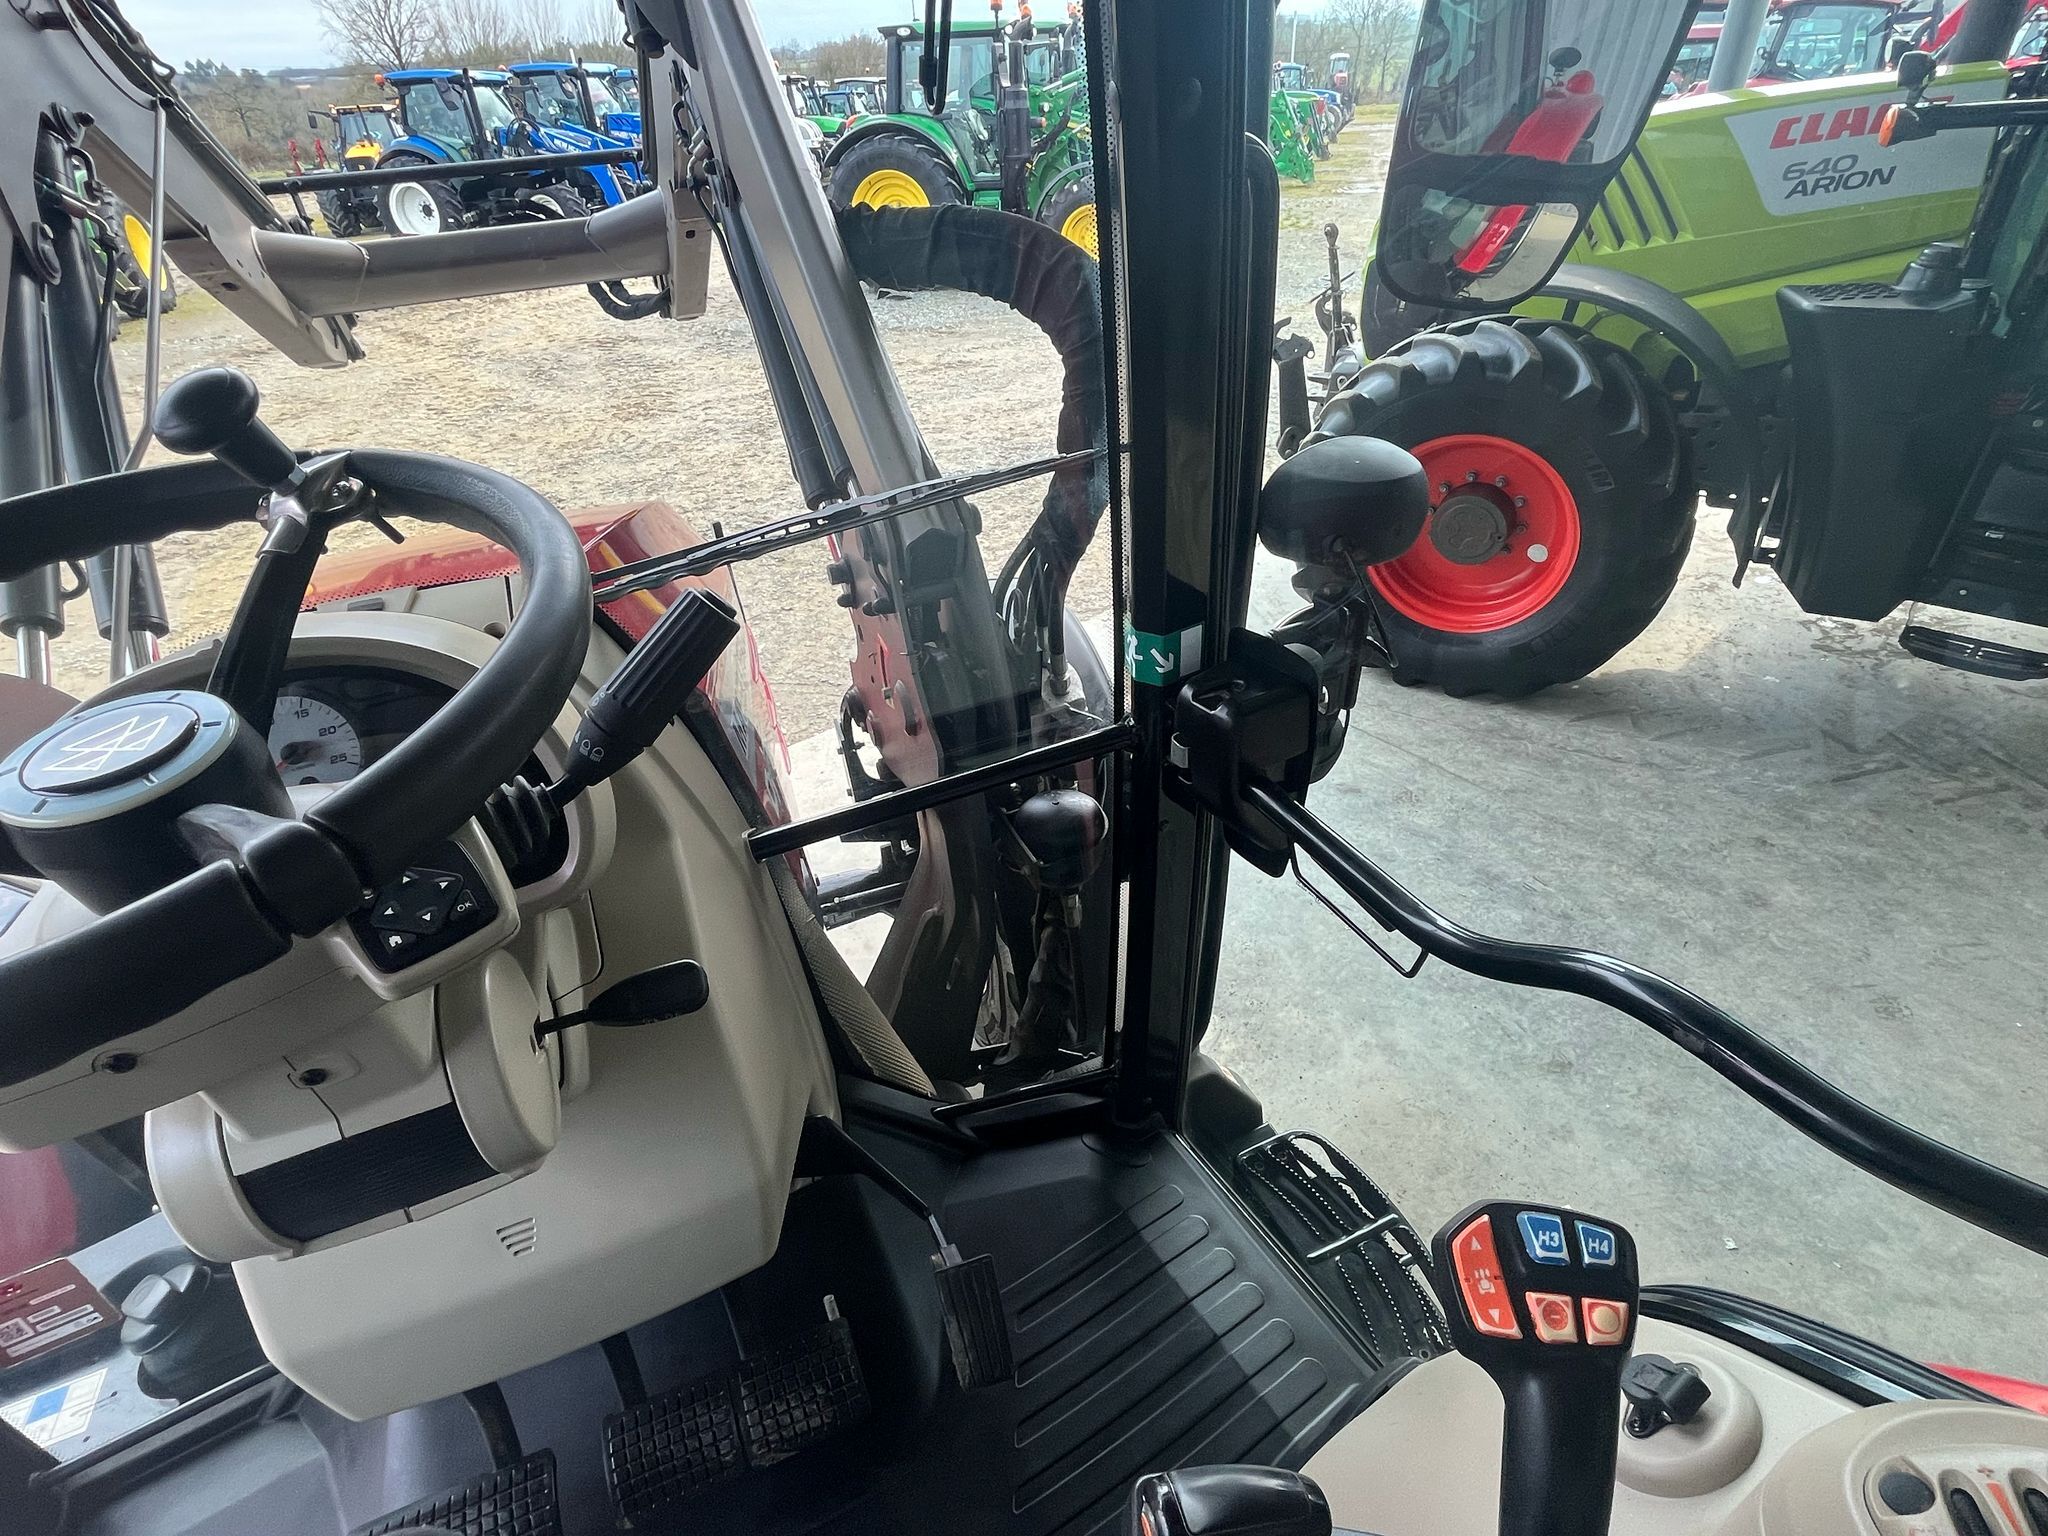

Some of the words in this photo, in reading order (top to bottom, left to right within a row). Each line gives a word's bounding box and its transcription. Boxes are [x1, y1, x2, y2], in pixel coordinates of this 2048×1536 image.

[1782, 154, 1859, 182] 640
[1784, 165, 1897, 199] ARION
[293, 708, 310, 720] 15
[318, 725, 337, 737] 20
[329, 752, 348, 765] 25
[456, 900, 473, 912] OK
[1538, 1230, 1560, 1247] H3
[1587, 1236, 1609, 1254] H4
